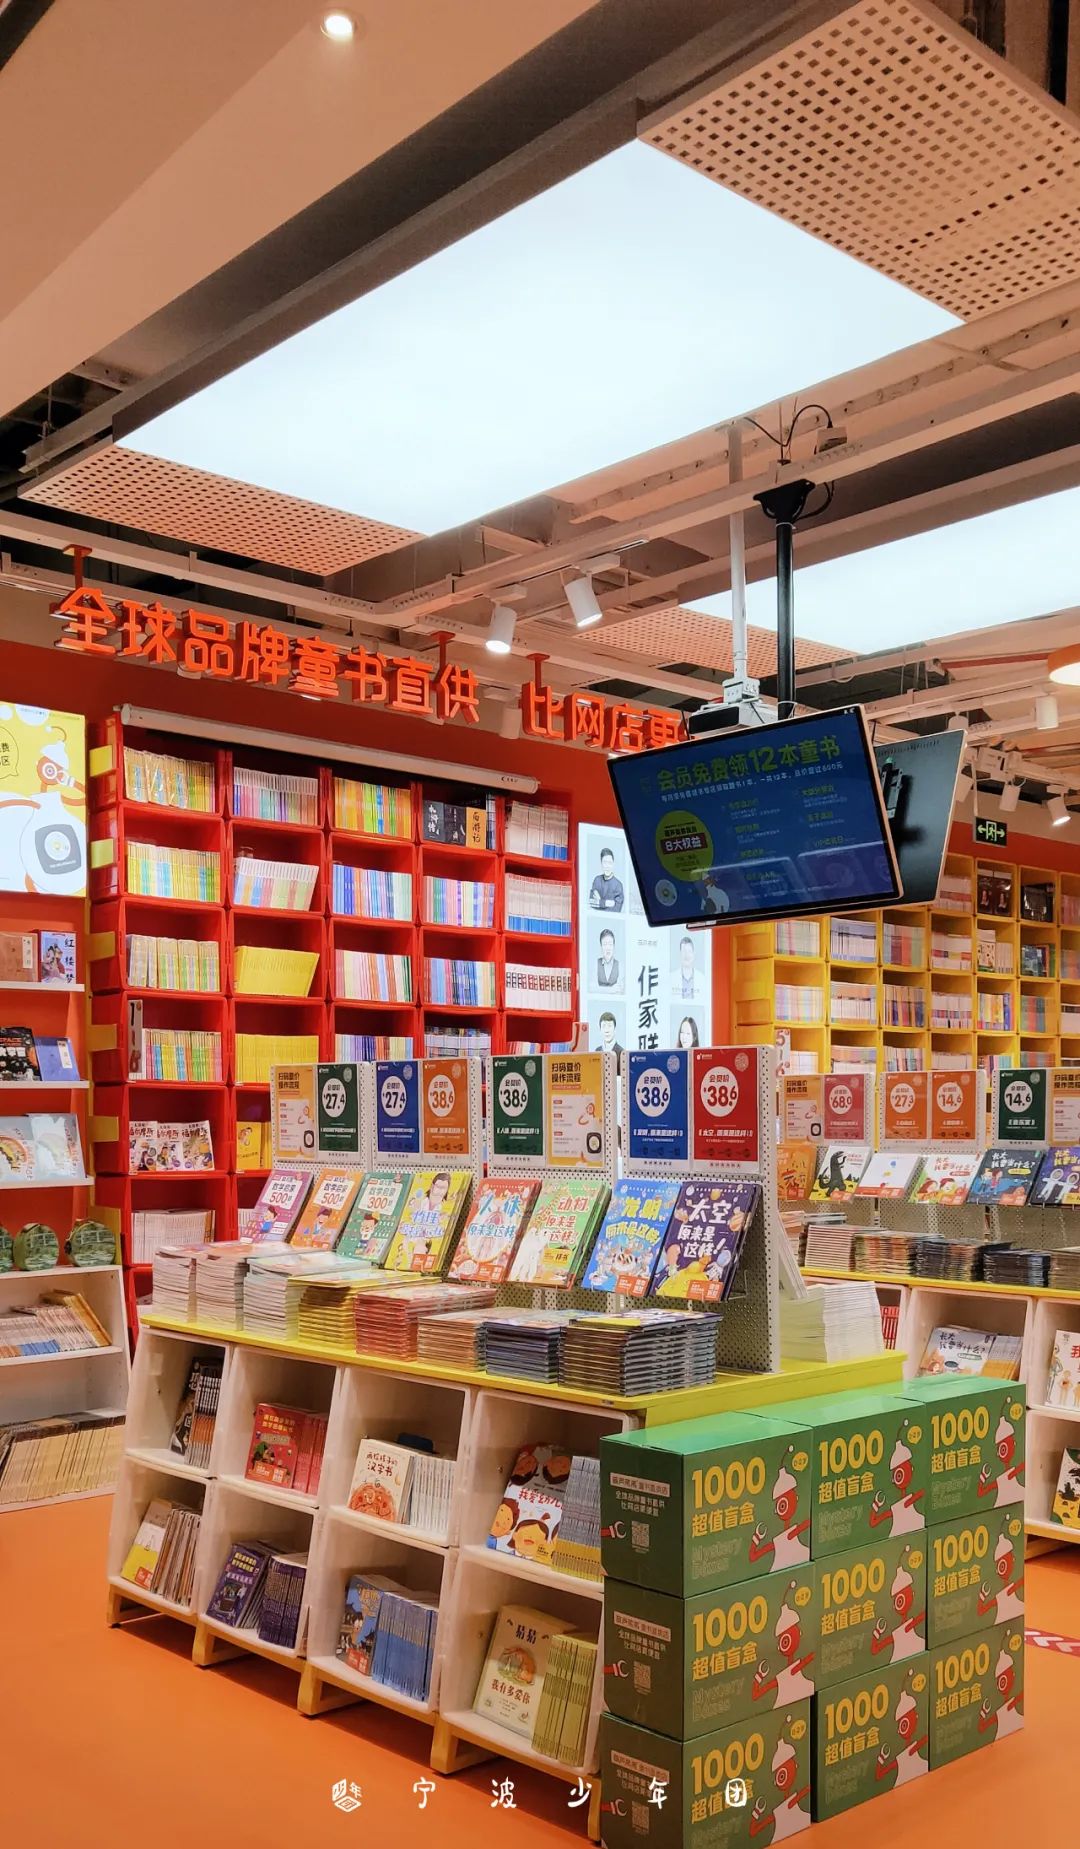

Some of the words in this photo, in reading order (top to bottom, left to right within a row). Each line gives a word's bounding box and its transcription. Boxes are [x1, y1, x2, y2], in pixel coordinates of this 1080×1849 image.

[54, 587, 480, 725] 全球品牌童书直供
[658, 735, 842, 791] 会员免费领12本童书
[665, 836, 702, 852] 8大权益
[64, 938, 75, 984] 红楼梦
[272, 1182, 295, 1193] 数学启蒙
[324, 1183, 347, 1194] 数学启蒙
[480, 1193, 521, 1218] 人体
[546, 1215, 577, 1228] 原来是
[688, 1199, 732, 1224] 太空
[677, 1224, 715, 1241] 原来是
[940, 1332, 955, 1340] 长大
[931, 1406, 990, 1448] 1000
[367, 1461, 394, 1477] 汉字书
[819, 1430, 884, 1477] 1000
[931, 1445, 981, 1475] 超值盲盒
[519, 1487, 563, 1510] 我爱幼儿
[692, 1456, 766, 1509] 1000
[818, 1471, 874, 1505] 超值盲盒
[691, 1502, 755, 1538] 超值盲盒
[933, 1525, 989, 1572] 1000
[821, 1558, 885, 1609] 1000
[934, 1564, 981, 1598] 超值盲盒
[693, 1596, 768, 1653] 1000
[821, 1600, 876, 1636] 超值盲盒
[692, 1641, 758, 1681] 超值盲盒
[935, 1643, 990, 1694] 1000
[491, 1679, 531, 1704] 我有多爱你
[936, 1683, 982, 1719] 超值盲盒
[825, 1684, 889, 1739] 1000
[691, 1733, 765, 1795] 1000
[825, 1726, 880, 1766] 超值盲盒
